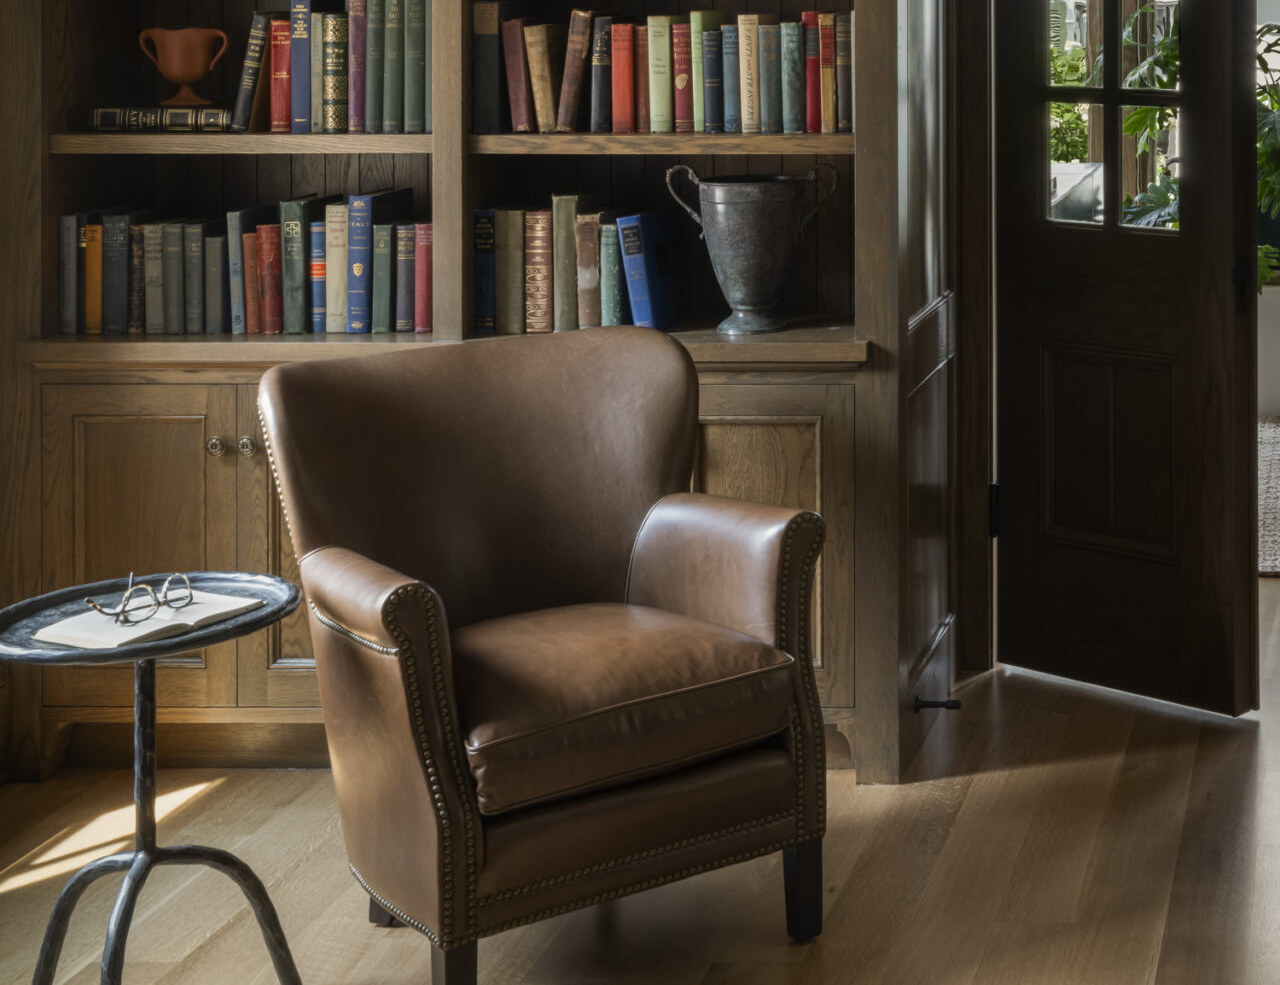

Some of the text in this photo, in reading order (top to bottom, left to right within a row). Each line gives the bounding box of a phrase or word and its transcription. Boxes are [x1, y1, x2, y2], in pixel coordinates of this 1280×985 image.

[248, 38, 265, 46] SAINTS
[744, 27, 753, 58] SAINTS
[745, 71, 754, 121] STRANGERS
